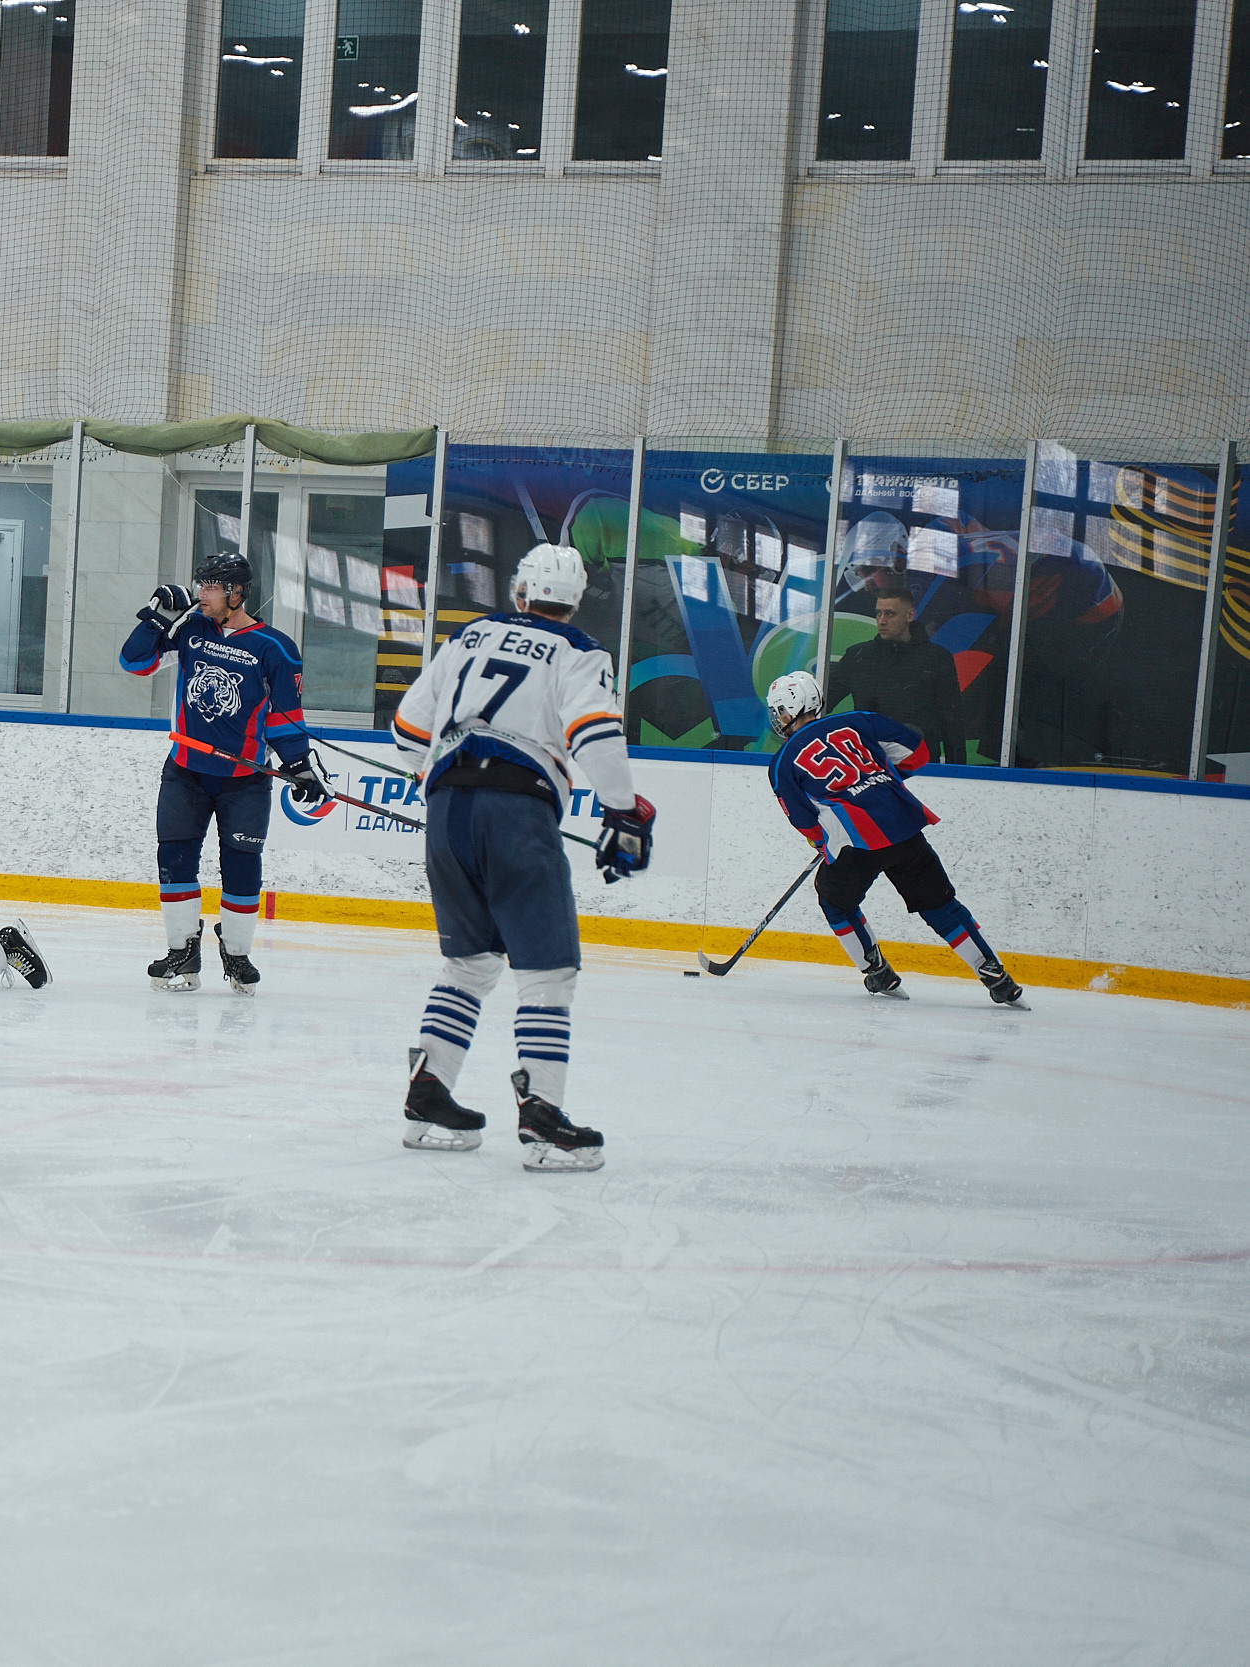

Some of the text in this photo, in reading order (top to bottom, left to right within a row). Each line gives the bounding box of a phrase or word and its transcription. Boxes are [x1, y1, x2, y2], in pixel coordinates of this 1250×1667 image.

[731, 473, 790, 491] СБЕР
[855, 488, 896, 497] ДАЛЬНИЙ
[203, 640, 259, 665] ТРАНСНЕФТЬ
[499, 630, 559, 665] East
[439, 656, 532, 739] 17
[793, 727, 886, 792] 50
